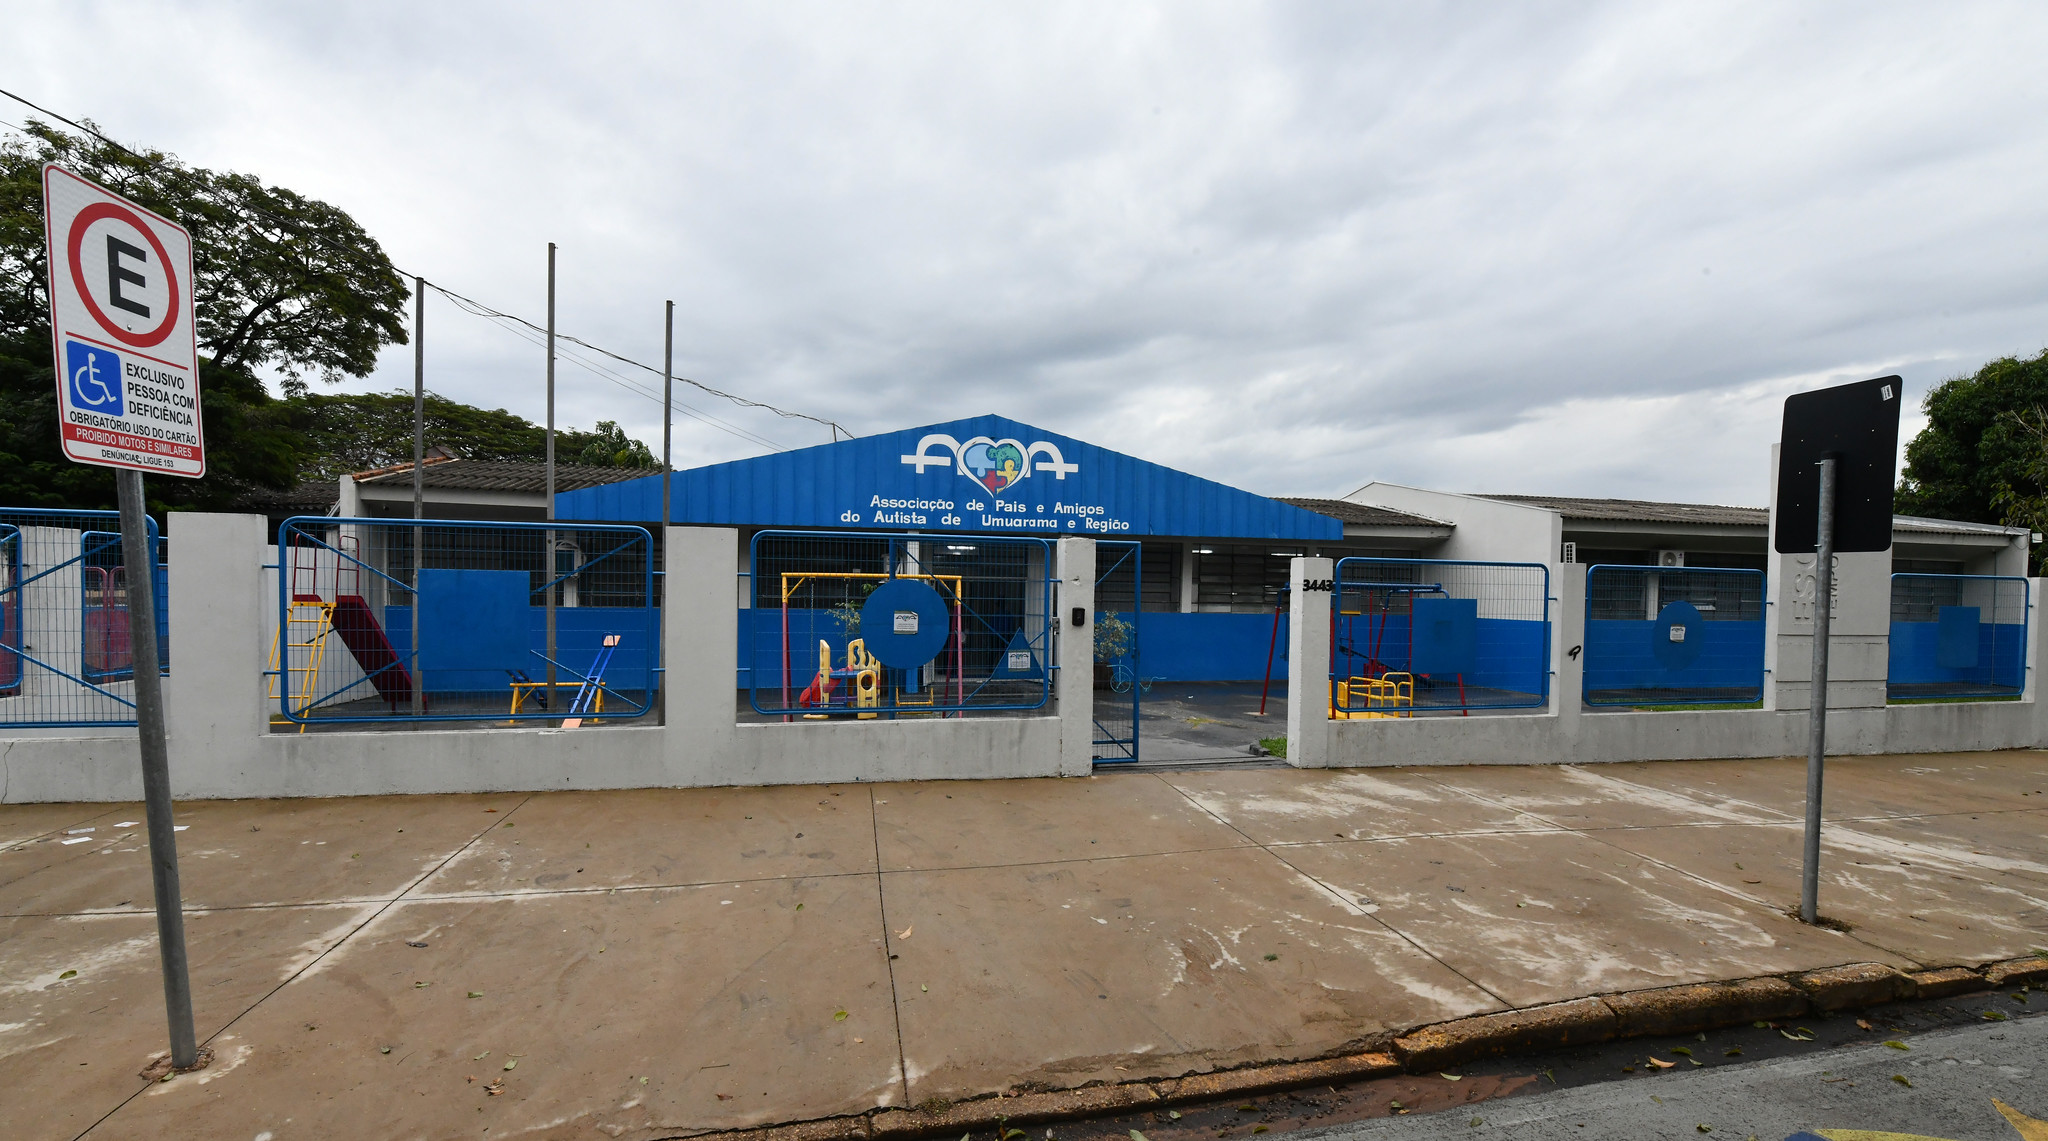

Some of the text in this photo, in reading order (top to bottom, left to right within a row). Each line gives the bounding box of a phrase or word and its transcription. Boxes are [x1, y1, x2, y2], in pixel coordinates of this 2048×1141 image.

[107, 234, 150, 319] E
[126, 362, 185, 390] EXCLUSIVO
[127, 381, 195, 410] PESSOA COM
[128, 400, 193, 427] DEFICIÊNCIA
[70, 410, 197, 445] OBRIGATÓRIO USO DO CARTÃO
[76, 427, 192, 458] PROIBIDO MOTOS E SIMILARES
[143, 456, 163, 466] LIGUE
[163, 459, 174, 468] 153
[870, 495, 1105, 518] Associação de Pais e Amigos
[840, 510, 1130, 533] do Autista de Umuarama e Região
[1302, 579, 1334, 592] 3443
